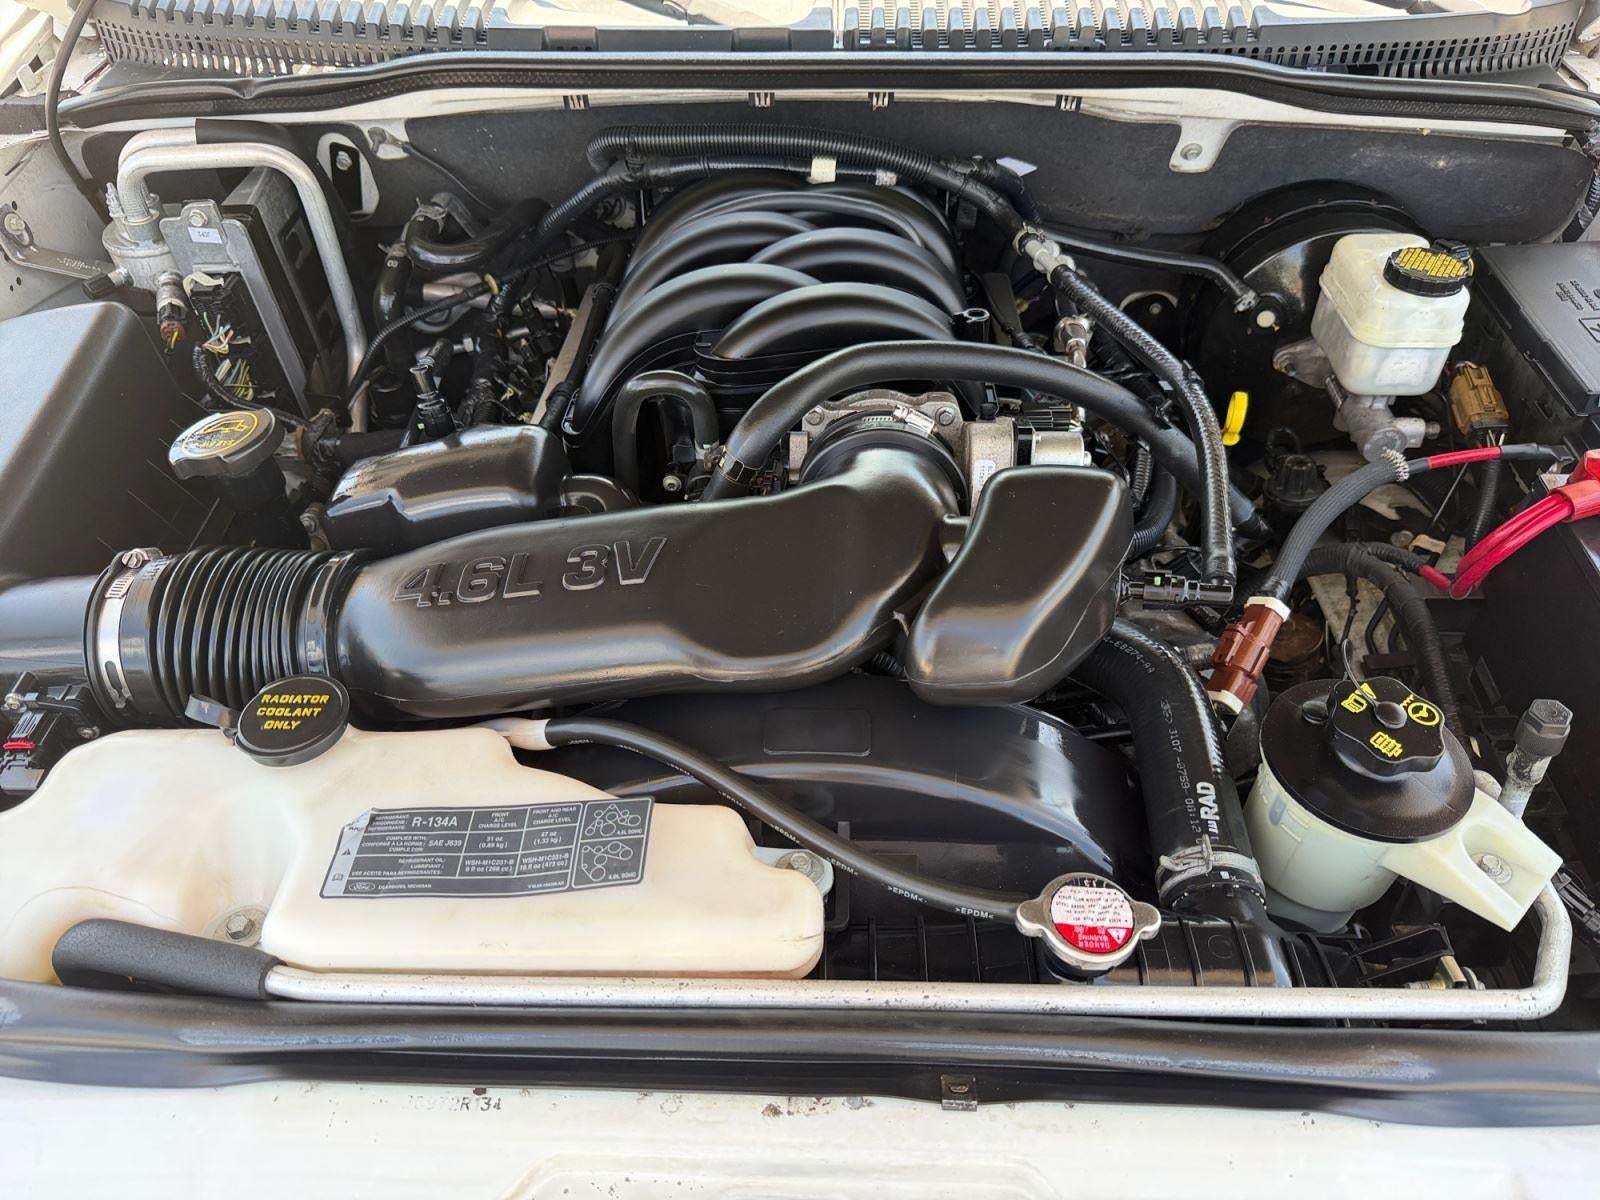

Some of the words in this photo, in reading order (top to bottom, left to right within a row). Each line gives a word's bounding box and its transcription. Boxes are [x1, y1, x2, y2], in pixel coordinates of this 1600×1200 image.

[394, 552, 543, 607] 4.6L
[562, 537, 667, 591] 3V
[261, 694, 329, 704] RADIATOR
[257, 707, 321, 717] COOLANT
[264, 720, 301, 730] ONLY
[1196, 782, 1220, 820] RAD
[411, 816, 458, 827] R-134A
[1078, 934, 1109, 942] WARNING
[1077, 940, 1110, 949] DANGER
